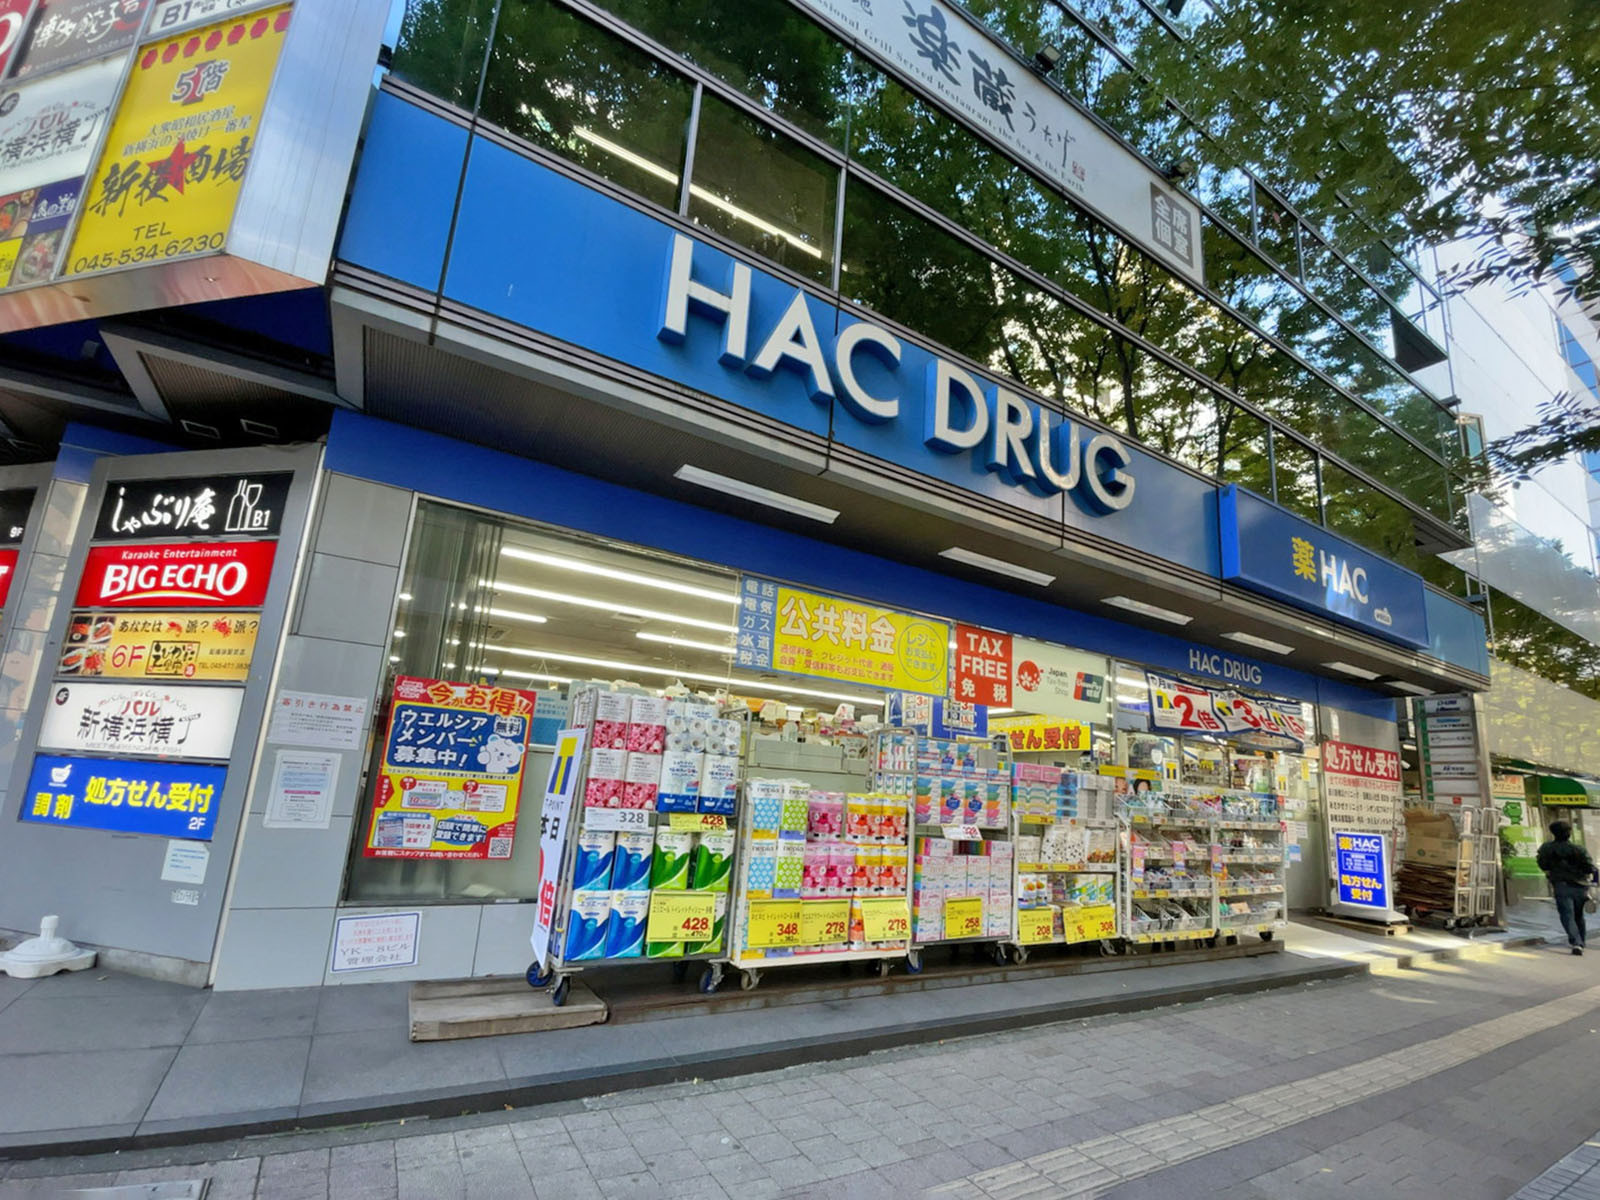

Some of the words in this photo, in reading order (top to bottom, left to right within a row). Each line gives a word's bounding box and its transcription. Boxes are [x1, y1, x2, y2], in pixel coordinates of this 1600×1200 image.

[161, 0, 193, 27] B1
[864, 28, 893, 54] Grill
[896, 51, 934, 84] Served
[1060, 170, 1086, 193] Earth
[1022, 101, 1076, 168] うたげ
[133, 222, 172, 241] TEL
[74, 232, 225, 273] 045-534-6230
[659, 232, 899, 422] HAC
[926, 358, 1136, 514] DRUG
[112, 487, 216, 533] しゃぶり庵
[252, 510, 270, 527] B1
[122, 550, 160, 560] Karaoke
[163, 548, 237, 559] Entertainment
[101, 565, 158, 598] BIG
[161, 562, 248, 597] ECHO
[1292, 536, 1317, 582] 薬
[1320, 549, 1368, 604] HAC
[746, 579, 774, 597] 電話
[745, 597, 773, 615] 電気
[118, 620, 163, 633] あなたは
[743, 615, 770, 631] ガス
[780, 596, 896, 655] 公共料金
[741, 634, 770, 649] 水道
[966, 632, 1004, 657] TAX
[112, 645, 146, 668] 6F
[739, 650, 769, 667] 税金
[960, 654, 1008, 680] FREE
[1189, 649, 1220, 675] HAC
[1224, 659, 1262, 684] DRUG
[961, 678, 1007, 702] 免税
[121, 700, 160, 716] バル
[1173, 695, 1220, 729] 2倍
[78, 707, 201, 745] 新横浜横丁
[401, 709, 488, 731] ウエルシア
[495, 721, 520, 734] 無料
[397, 726, 473, 746] メンバー
[1010, 726, 1081, 750] せん受付
[1325, 743, 1399, 778] 処方せん受付
[32, 792, 75, 819] 調剤
[84, 776, 214, 813] 処方せん受付
[188, 817, 206, 830] 2F
[620, 811, 644, 824] 328
[701, 814, 724, 826] 428
[1353, 838, 1380, 849] HAC
[682, 917, 708, 930] 428
[777, 923, 798, 936] 348
[826, 922, 845, 934] 278
[888, 919, 907, 931] 278
